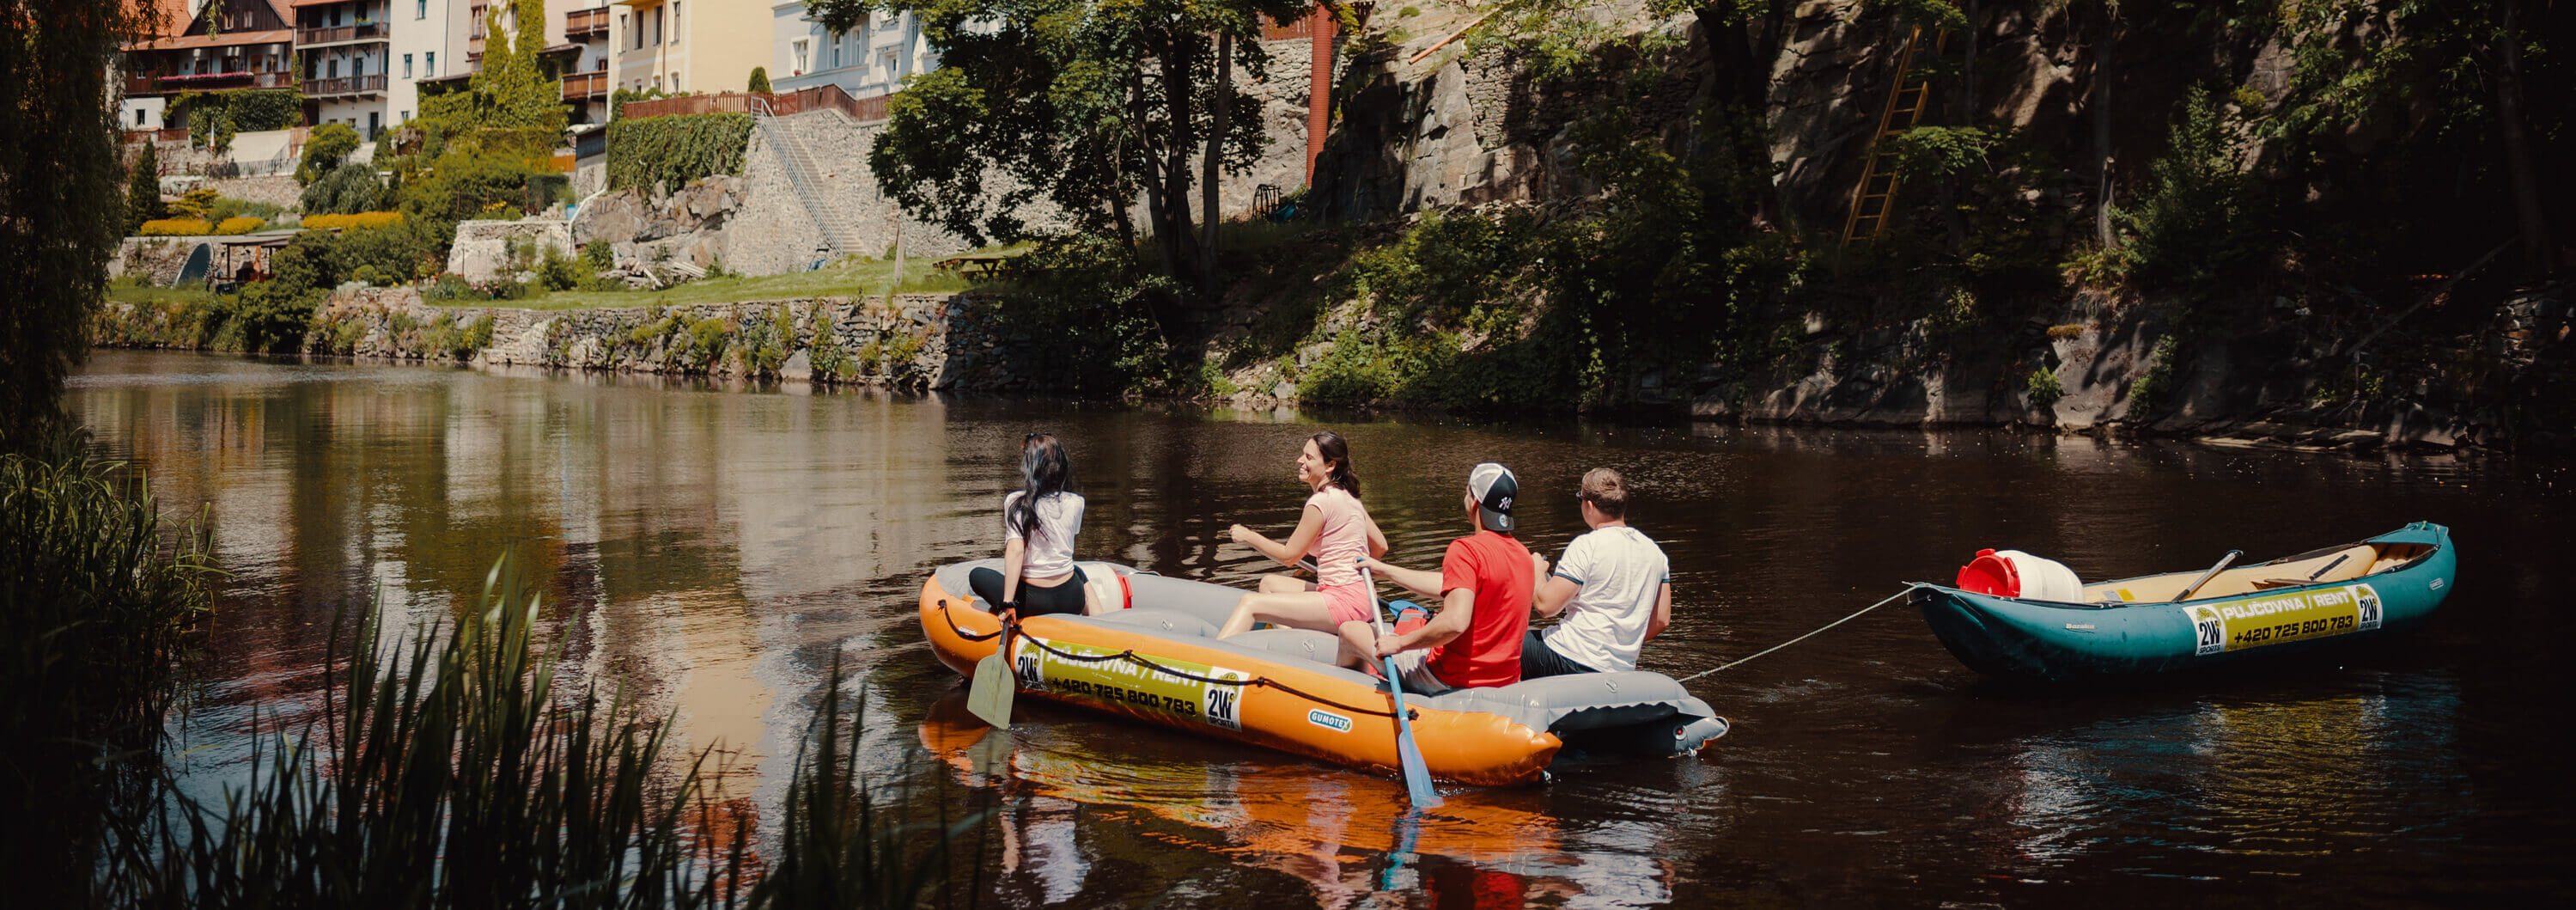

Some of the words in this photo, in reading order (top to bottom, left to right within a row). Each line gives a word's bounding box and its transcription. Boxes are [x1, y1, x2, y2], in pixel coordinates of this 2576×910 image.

[2312, 590, 2350, 607] RENT
[2234, 627, 2271, 644] +420
[2274, 622, 2299, 638] 725
[2302, 619, 2327, 633] 800
[2330, 614, 2354, 630] 783
[2199, 644, 2221, 653] SPORTS
[1051, 676, 1092, 694] +420
[1093, 683, 1124, 701] 725
[1127, 689, 1160, 707] 800
[1162, 695, 1196, 716] 783
[1311, 712, 1349, 730] GUMOTEX
